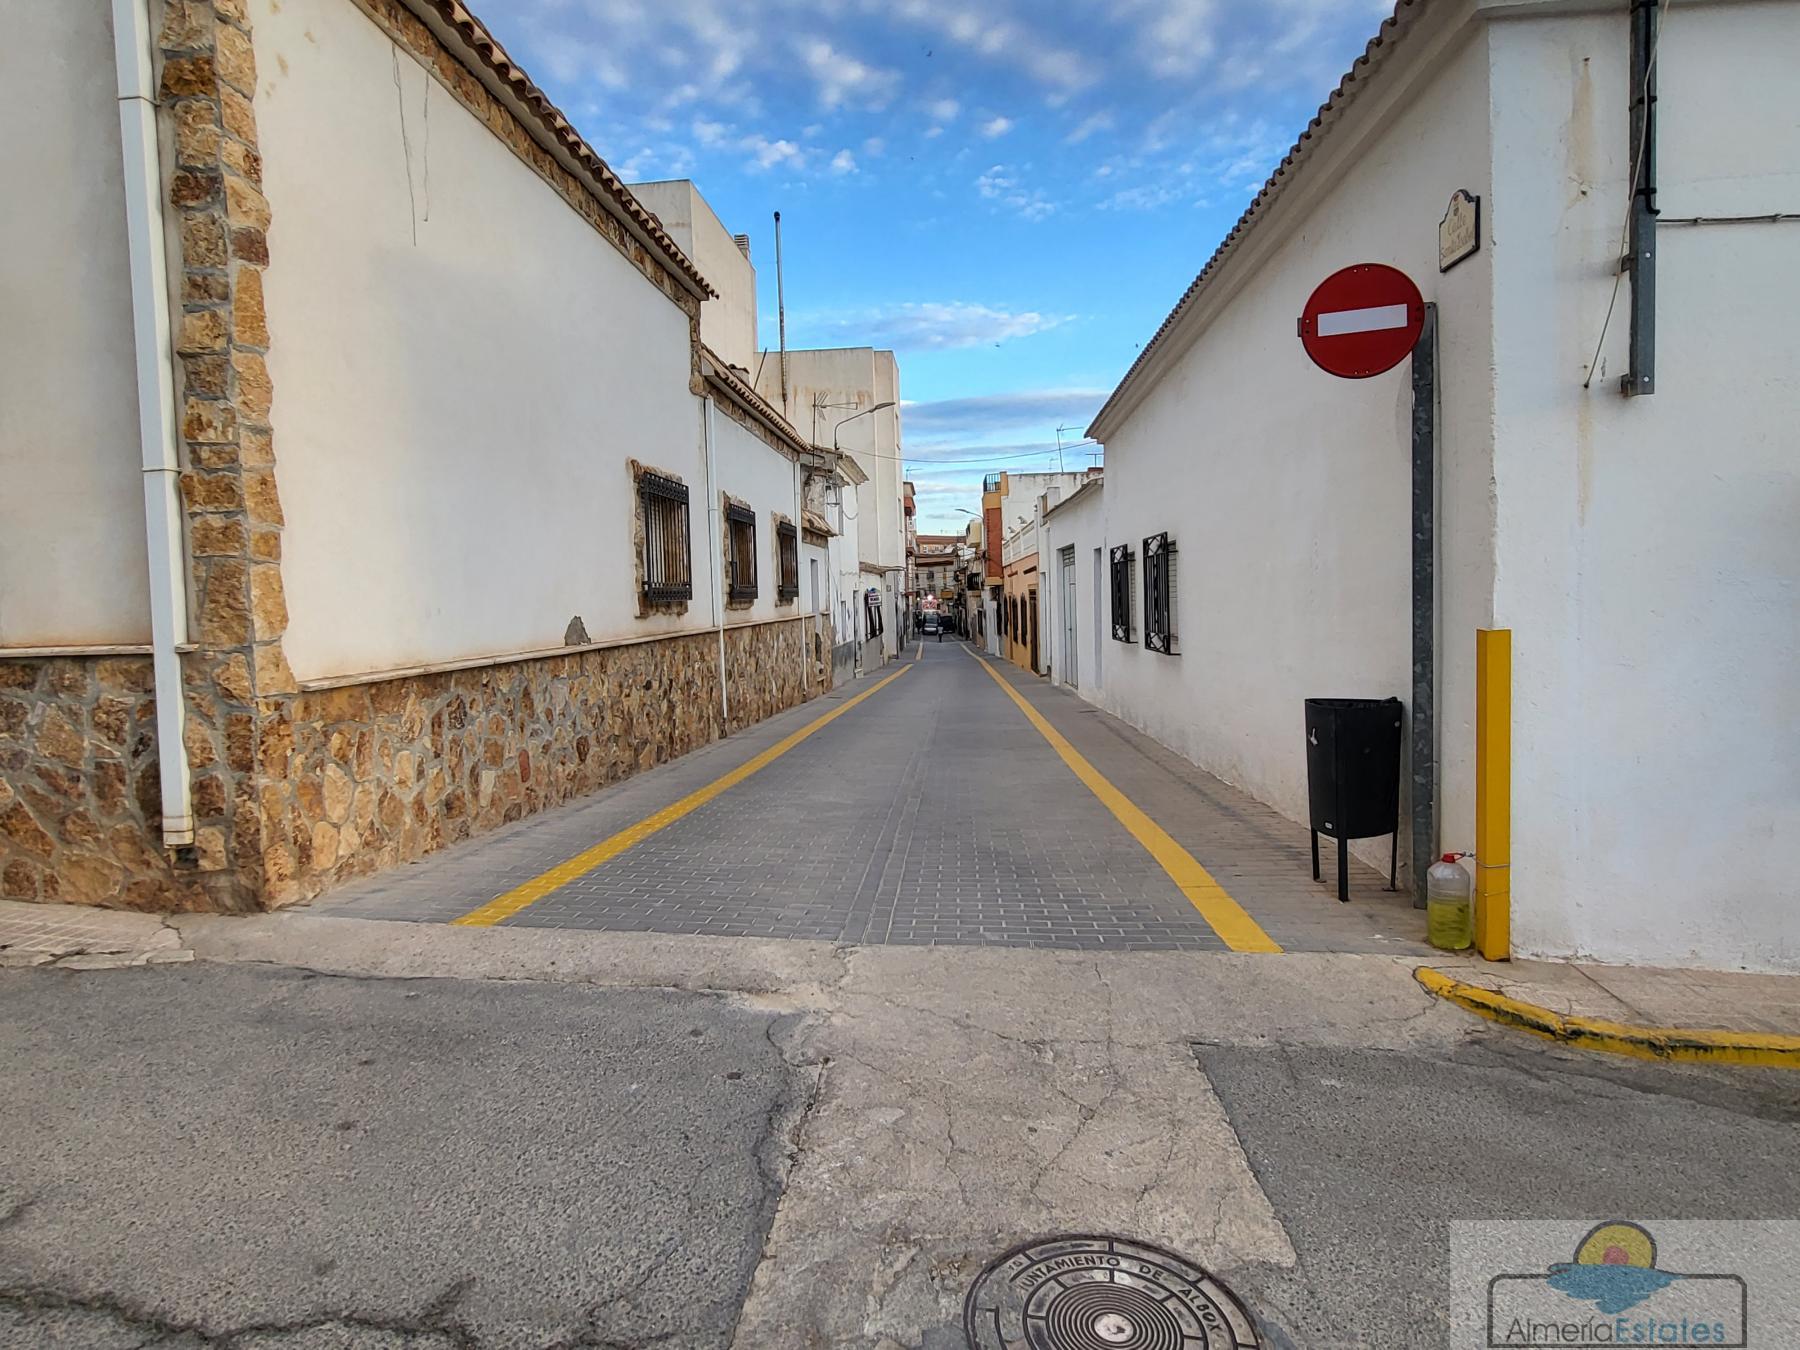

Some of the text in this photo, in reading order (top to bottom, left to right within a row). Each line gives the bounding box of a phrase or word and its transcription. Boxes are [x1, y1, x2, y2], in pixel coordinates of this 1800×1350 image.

[1447, 212, 1466, 236] Calle
[1139, 1265, 1164, 1281] DE
[1178, 1289, 1223, 1332] ALBOX
